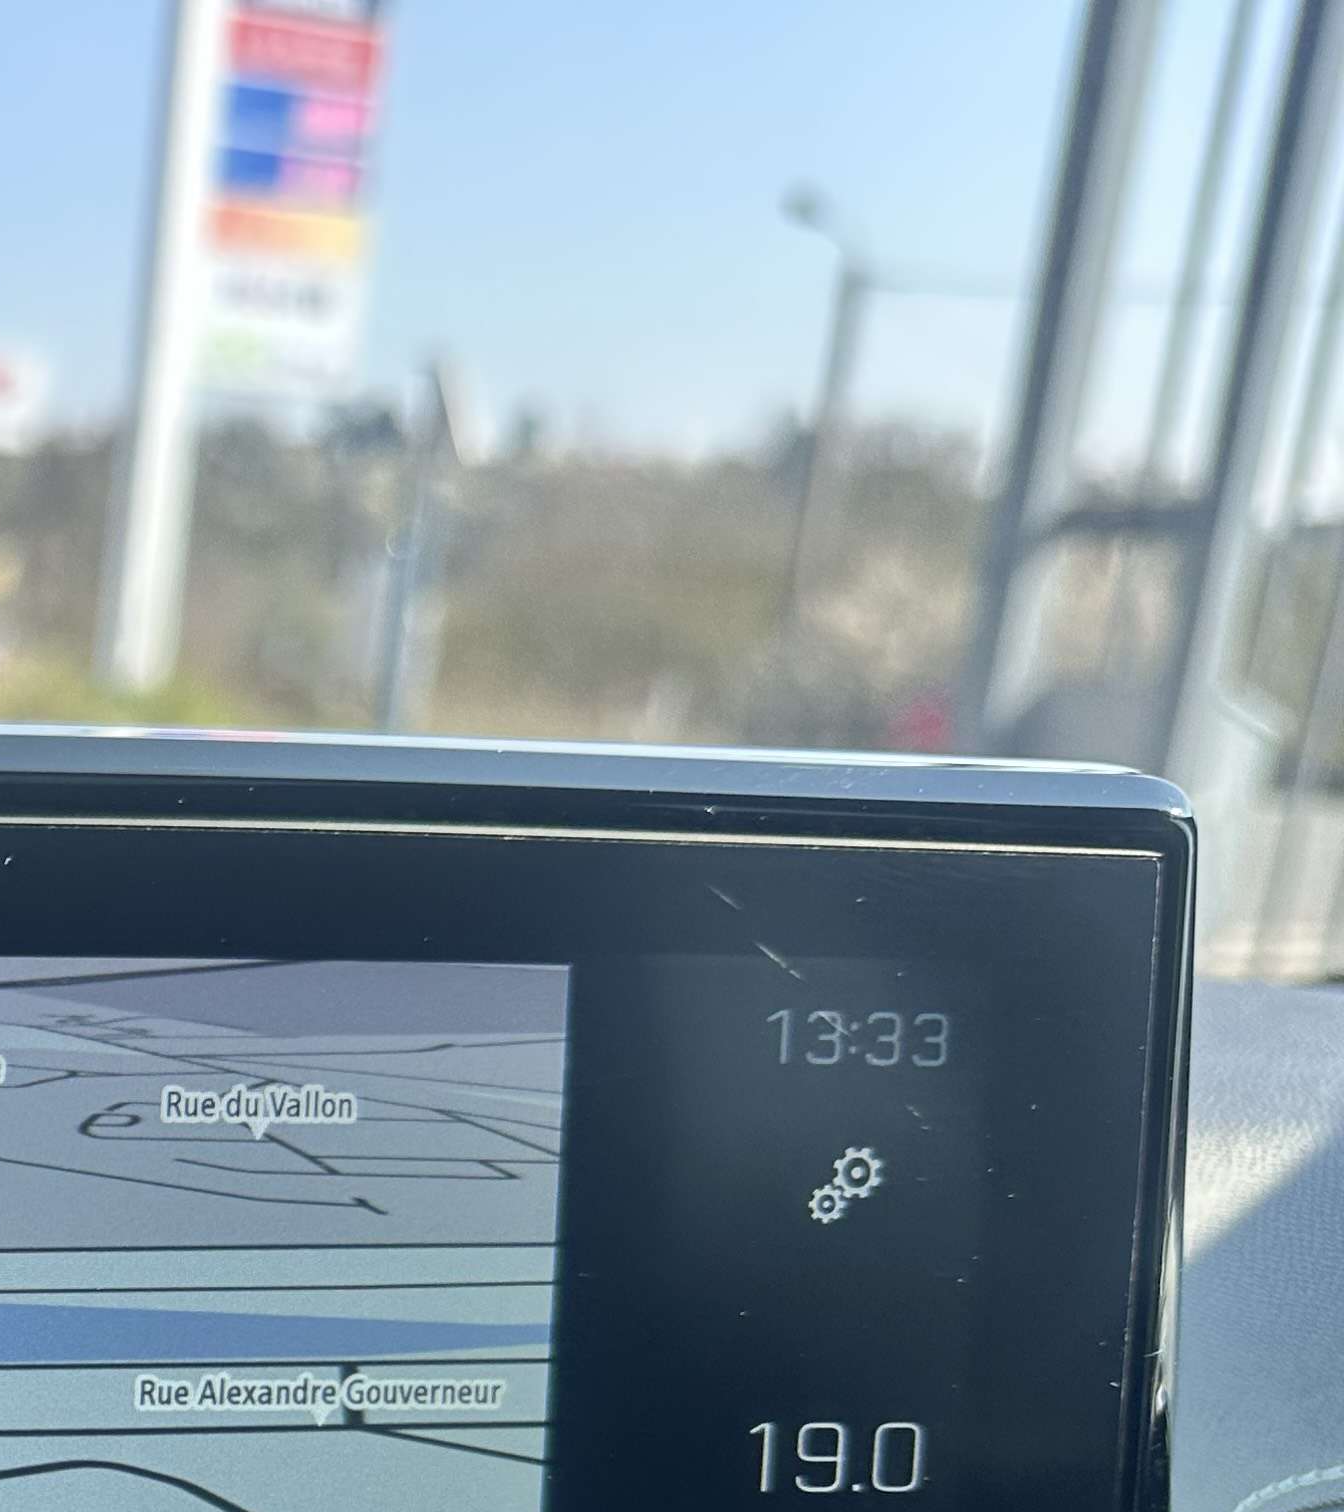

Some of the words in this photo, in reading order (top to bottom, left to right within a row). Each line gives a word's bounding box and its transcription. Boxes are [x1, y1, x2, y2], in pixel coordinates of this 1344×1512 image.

[766, 1009, 952, 1068] 13:33
[166, 1090, 217, 1118] Rue
[226, 1089, 259, 1118] du
[270, 1090, 353, 1119] Vallon
[139, 1380, 190, 1406] Rue
[198, 1378, 337, 1406] Alexandre
[346, 1379, 502, 1405] Gouverneur
[749, 1421, 926, 1494] 19.0
